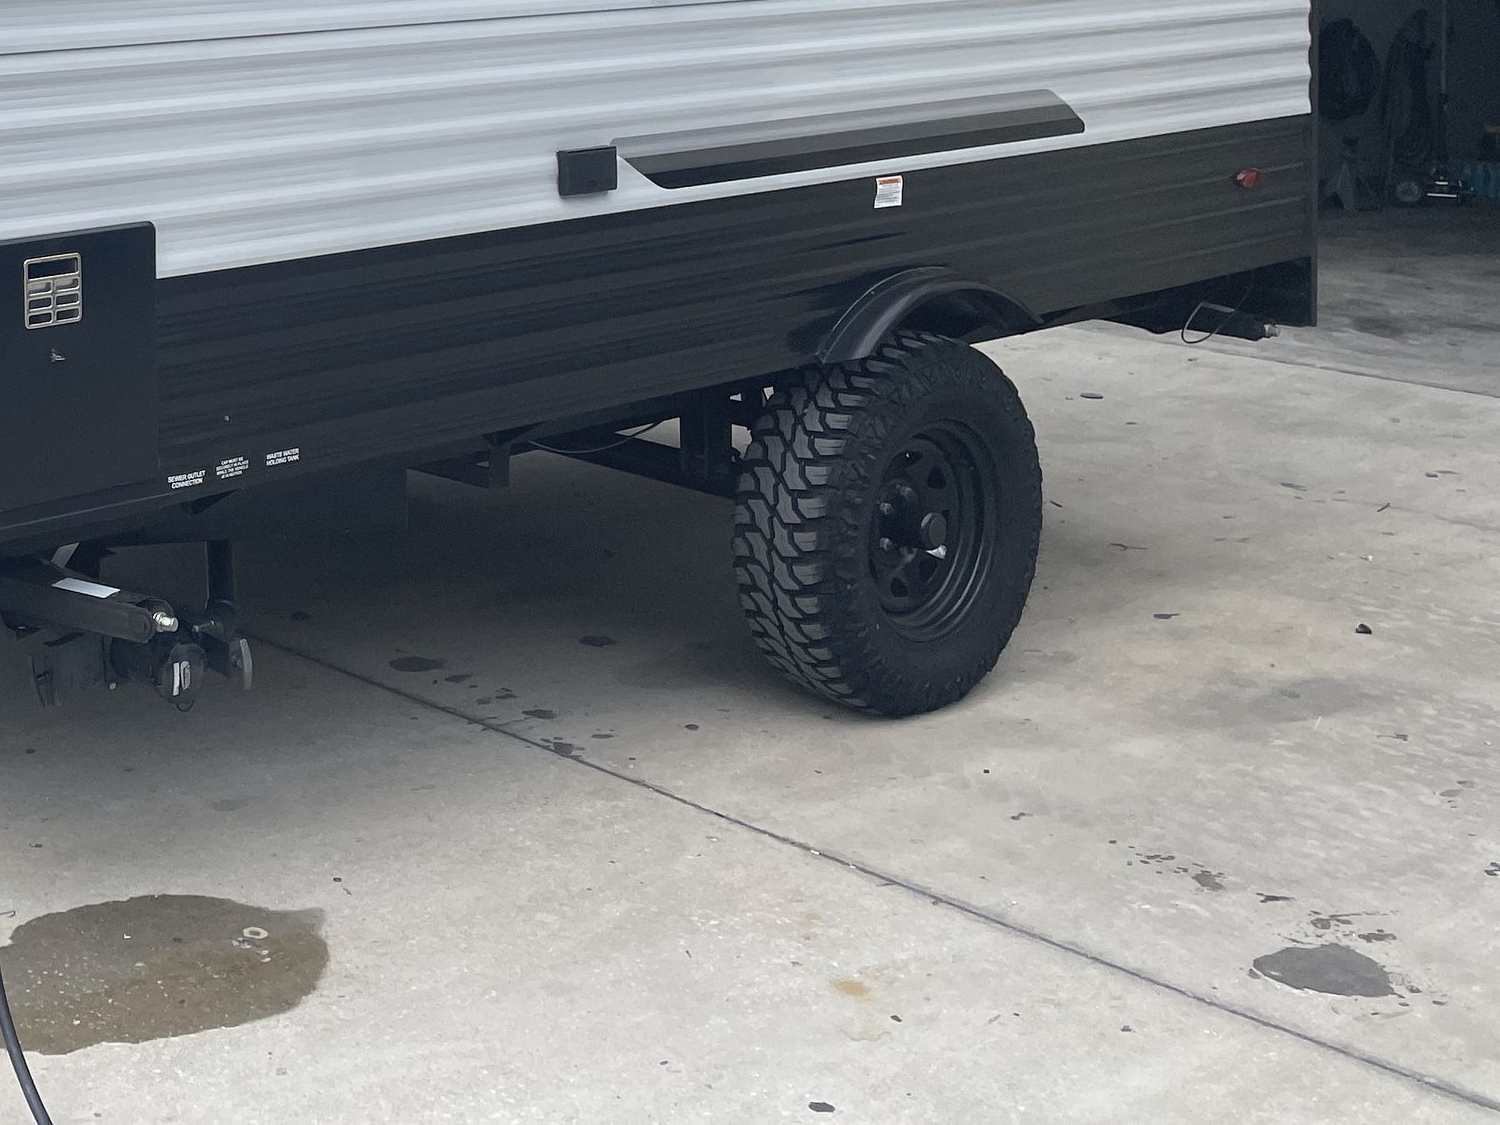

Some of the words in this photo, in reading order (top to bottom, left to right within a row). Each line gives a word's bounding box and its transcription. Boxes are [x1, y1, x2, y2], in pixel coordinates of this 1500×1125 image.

[167, 474, 187, 483] SEWER
[187, 469, 206, 479] OUTLET
[171, 477, 203, 489] CONNECTION
